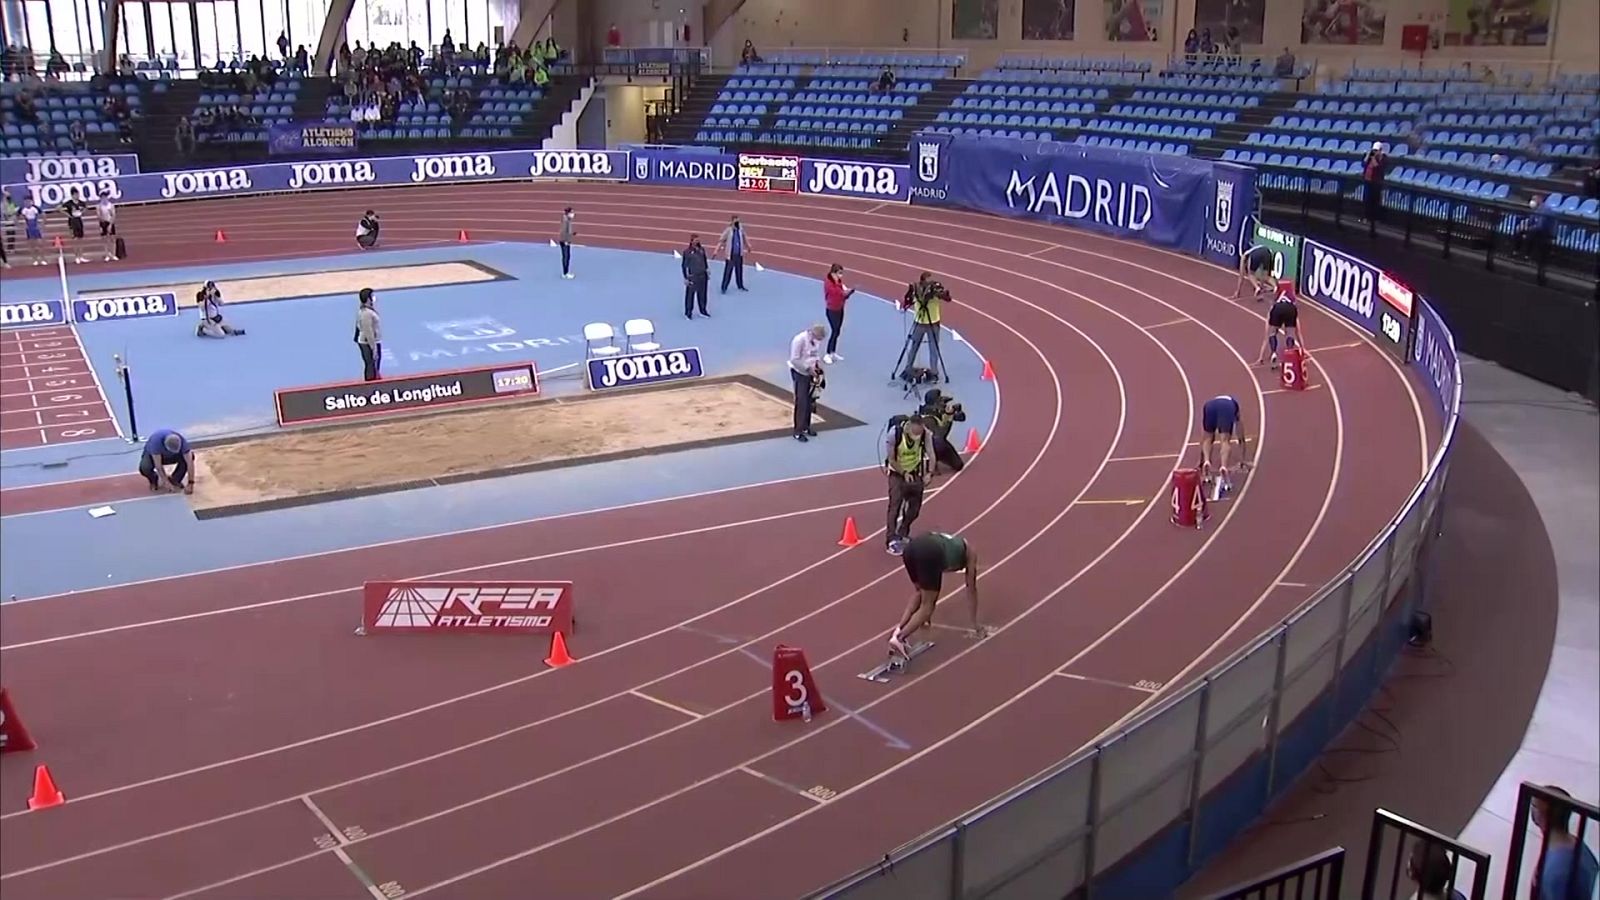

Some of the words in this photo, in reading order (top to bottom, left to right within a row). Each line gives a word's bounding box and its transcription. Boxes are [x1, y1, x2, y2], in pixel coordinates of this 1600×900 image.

[301, 127, 354, 137] ATLETISMO
[302, 136, 354, 147] ALCORCÓN
[659, 158, 736, 181] MADRID
[910, 185, 946, 200] MADRID
[1006, 169, 1153, 231] MADRID
[1206, 236, 1236, 257] MADRID
[1283, 362, 1296, 384] 5
[497, 375, 528, 387] 17:20
[50, 394, 83, 402] 6
[325, 392, 367, 411] Salto
[369, 389, 391, 405] de
[392, 380, 462, 405] Longitud
[56, 410, 89, 418] 7
[60, 428, 97, 437] 8
[1171, 487, 1180, 514] 4
[1190, 484, 1204, 511] 4
[444, 586, 564, 616] RFEA
[437, 615, 553, 627] ATLETISMO
[784, 670, 807, 706] 3
[1135, 679, 1163, 690] 800
[807, 784, 836, 799] 800
